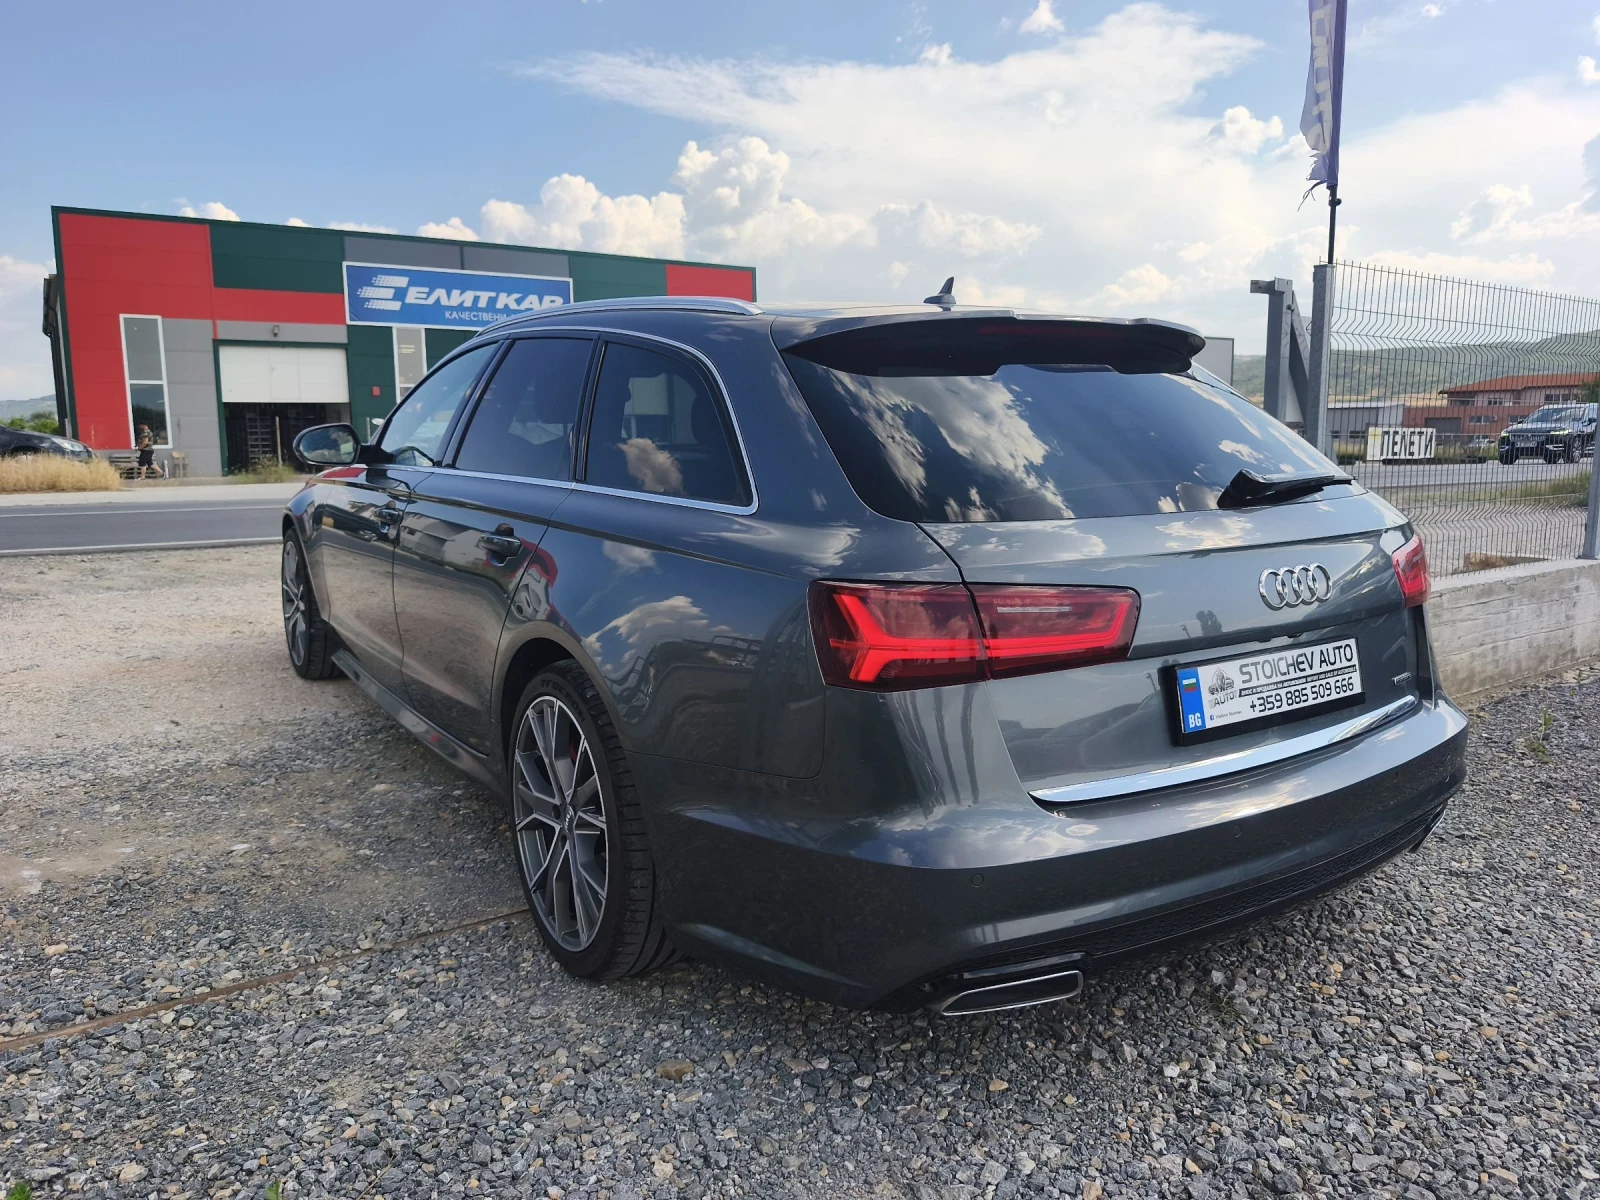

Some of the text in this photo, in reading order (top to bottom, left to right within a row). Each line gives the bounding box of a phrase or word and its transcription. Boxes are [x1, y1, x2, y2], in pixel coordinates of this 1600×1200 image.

[1380, 430, 1433, 457] ПЕЛЕТИ
[1239, 644, 1353, 684] STOICHEV AUTO
[1250, 693, 1283, 713] +359
[1285, 687, 1308, 706] 885
[1311, 681, 1332, 700] 509
[1334, 676, 1354, 694] 666
[1188, 712, 1202, 729] BG
